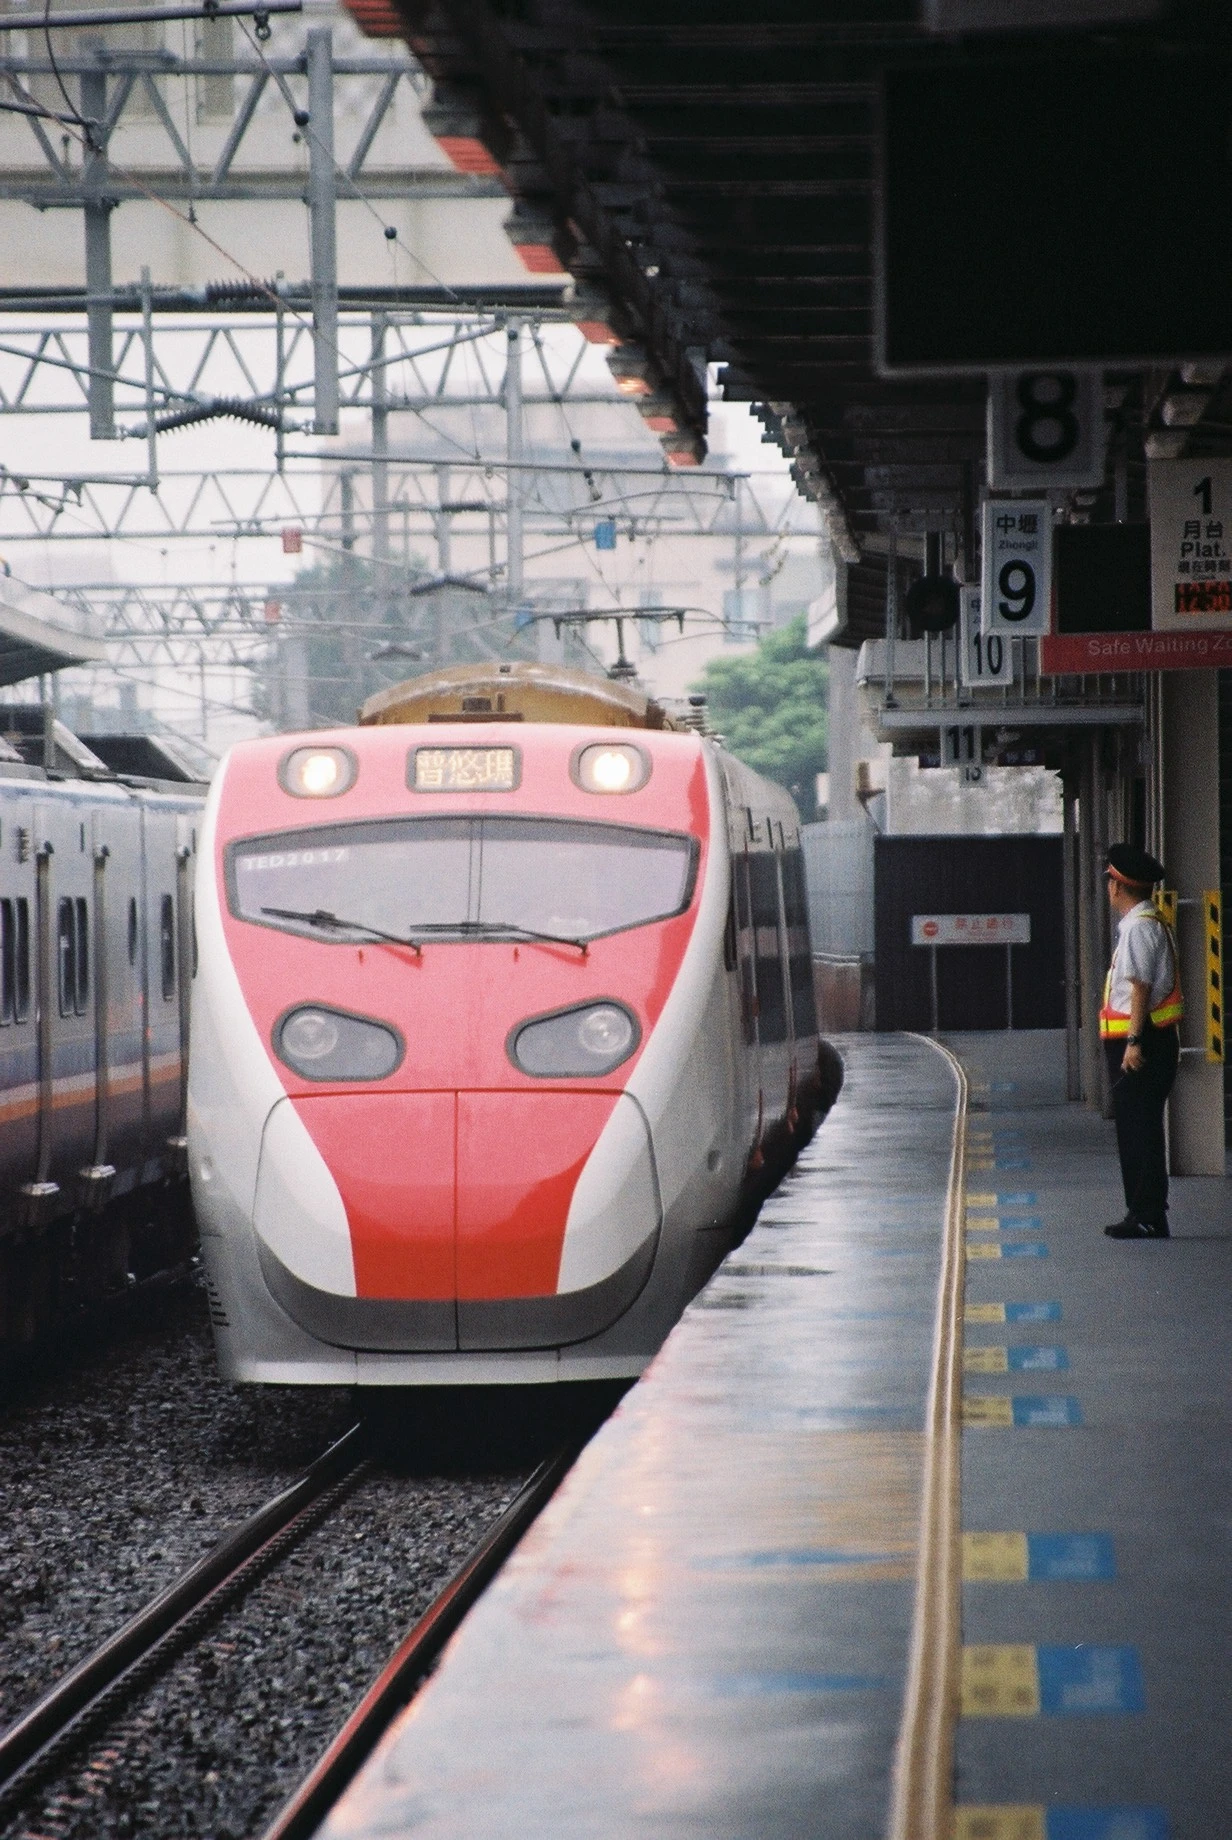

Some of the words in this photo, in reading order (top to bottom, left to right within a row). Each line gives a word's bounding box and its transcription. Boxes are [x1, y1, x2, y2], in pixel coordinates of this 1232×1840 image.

[1016, 370, 1079, 462] 8
[1194, 477, 1213, 514] 1
[997, 514, 1038, 534] 中壢
[1184, 520, 1224, 539] 月台
[999, 540, 1038, 551] Zhongli
[1181, 542, 1226, 557] Plat.
[998, 559, 1036, 622] 9
[973, 631, 1003, 675] 10
[1087, 639, 1131, 656] Safe
[1136, 637, 1208, 655] Waiting
[946, 725, 974, 760] 11
